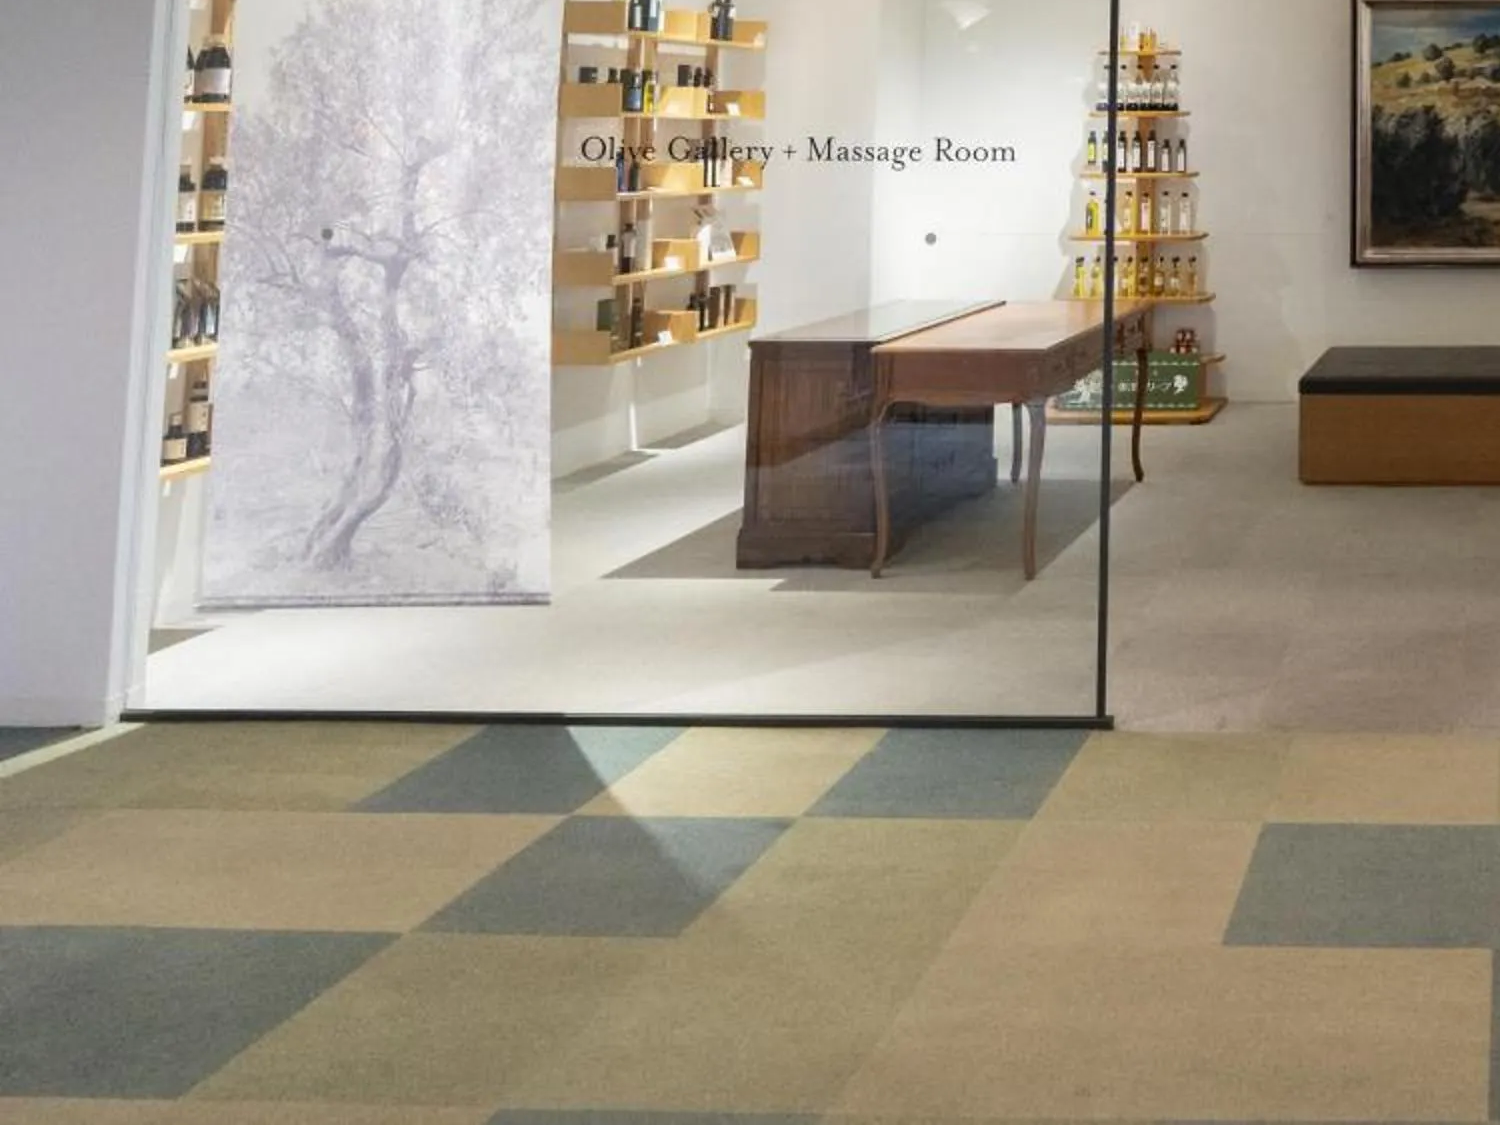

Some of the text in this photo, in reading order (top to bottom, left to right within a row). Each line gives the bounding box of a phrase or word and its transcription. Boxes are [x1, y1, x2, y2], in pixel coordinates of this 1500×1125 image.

[581, 136, 1016, 172] Olive Gallery + Massage Room
